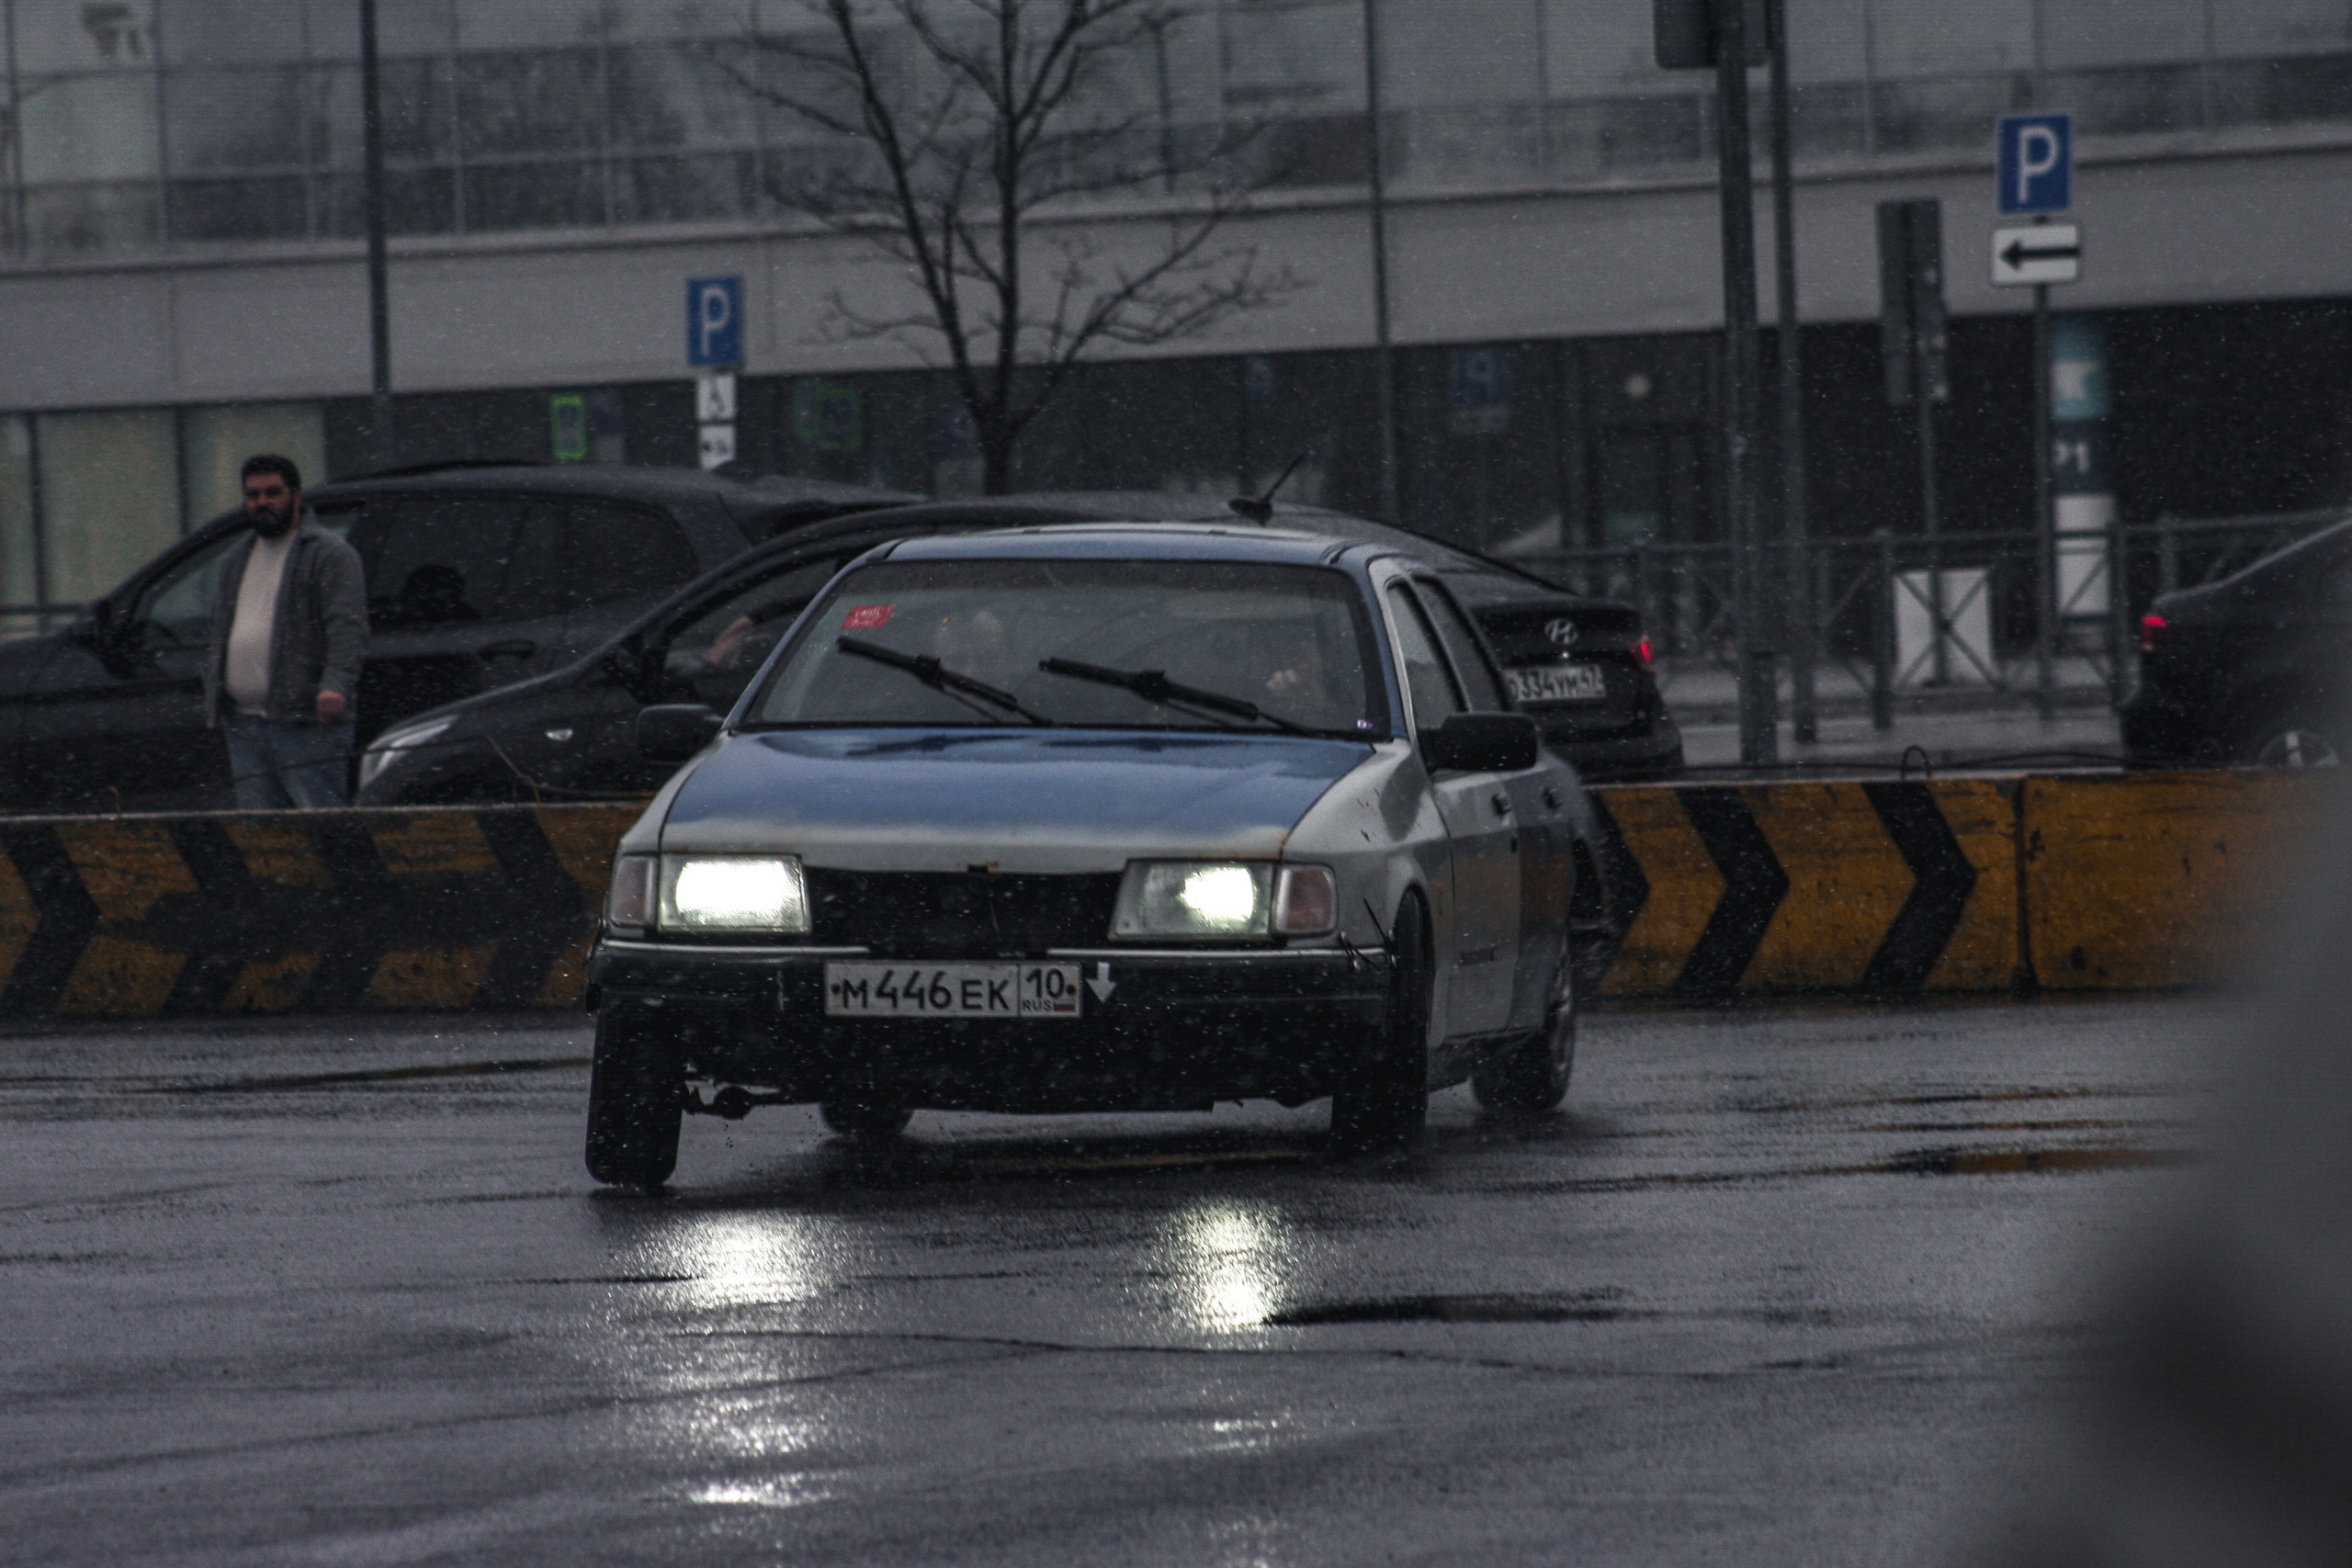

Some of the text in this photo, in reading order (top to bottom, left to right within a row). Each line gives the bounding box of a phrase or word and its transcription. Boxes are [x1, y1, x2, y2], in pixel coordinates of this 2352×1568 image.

[2017, 125, 2060, 205] P
[700, 287, 731, 357] P
[1022, 998, 1054, 1012] RUS
[1025, 967, 1066, 999] 10
